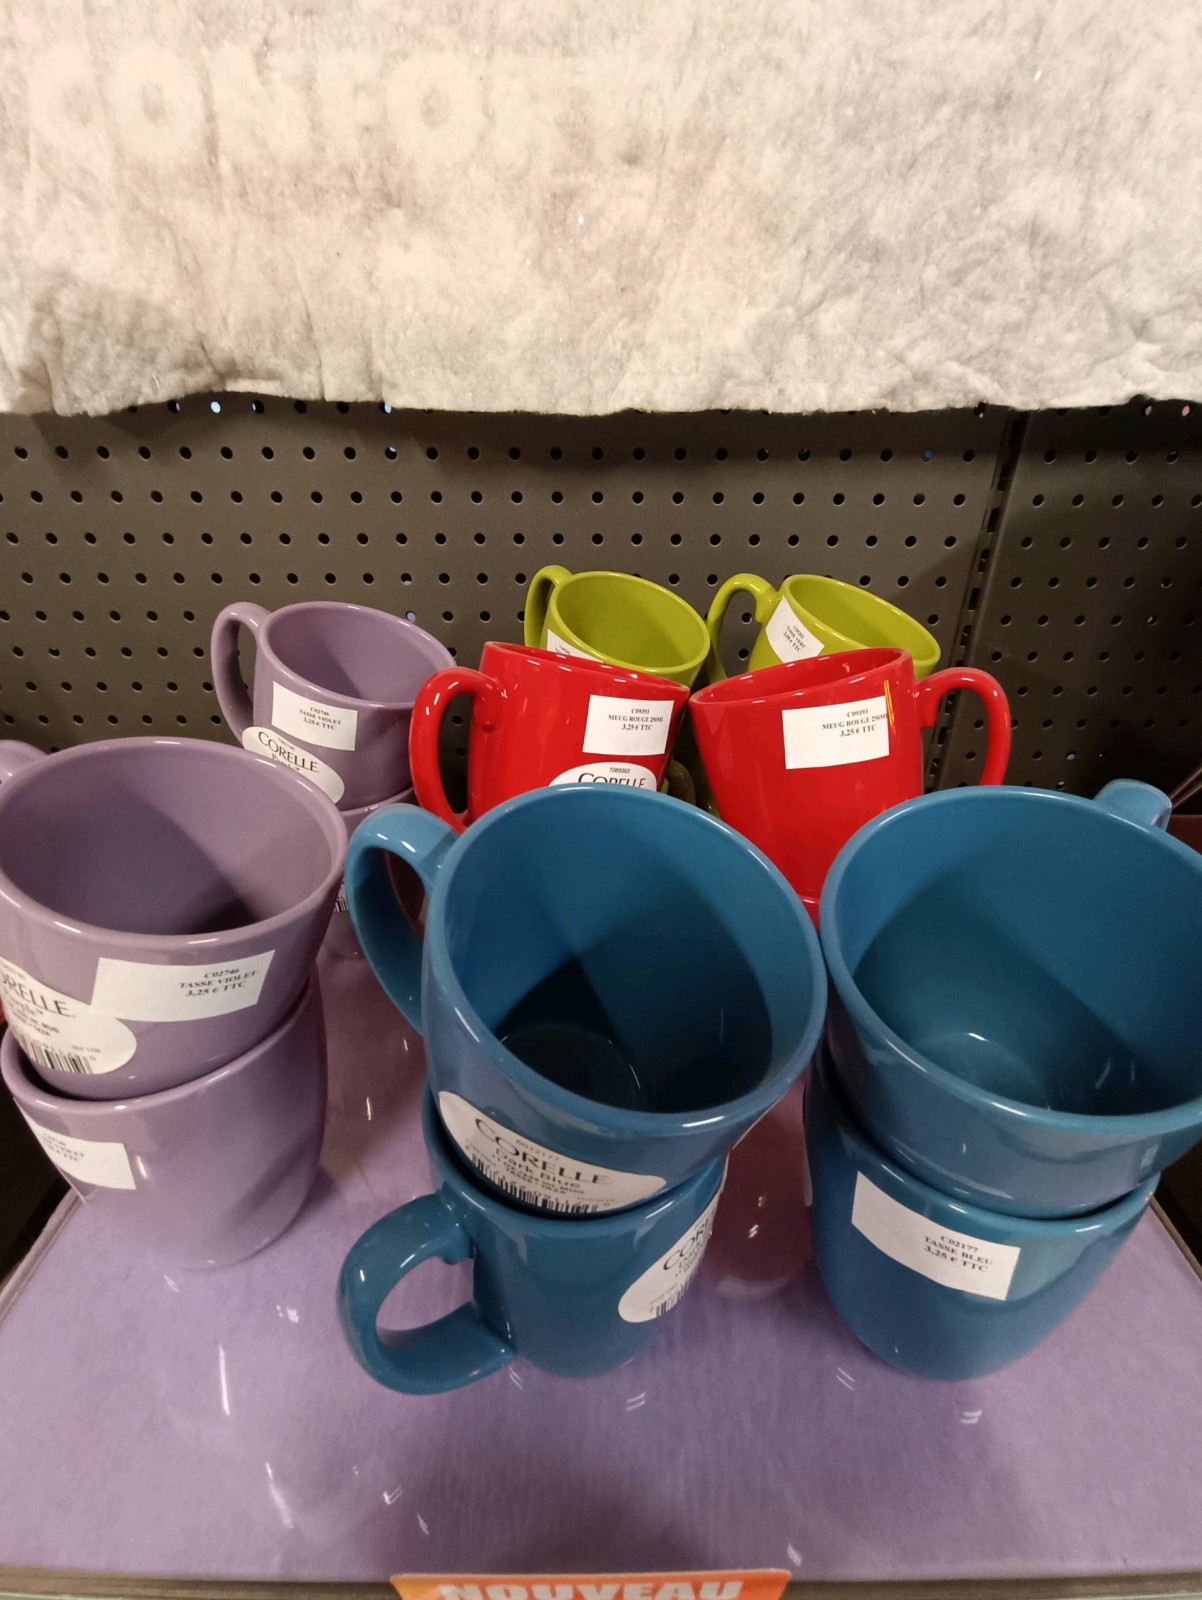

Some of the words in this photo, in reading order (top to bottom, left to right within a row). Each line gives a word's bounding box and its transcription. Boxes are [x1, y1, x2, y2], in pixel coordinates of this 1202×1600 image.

[299, 709, 317, 719] TASSE
[317, 715, 342, 725] VIOLET
[607, 714, 628, 722] MEUG
[629, 715, 650, 723] ROUGE
[821, 721, 845, 731] MEUG
[846, 716, 871, 727] ROUGE
[321, 722, 336, 731] TTC
[621, 723, 635, 731] 3,25
[839, 728, 855, 737] 3,25
[862, 724, 877, 734] TTC
[258, 731, 320, 774] CORELLE
[180, 980, 213, 989] TASSE
[217, 969, 257, 984] VIOLET
[204, 967, 240, 979] C02746
[185, 987, 210, 997] 3,25
[222, 980, 247, 991] TTC
[474, 1118, 611, 1185] CORELLE
[496, 1147, 535, 1174] Dark
[540, 1171, 581, 1189] Blue
[924, 1234, 957, 1255] TASSE
[961, 1251, 994, 1266] BLEU
[940, 1235, 979, 1253] C02177
[923, 1244, 948, 1260] 3,25
[960, 1259, 990, 1272] TTC
[438, 1580, 744, 1600] NOUVEAU
